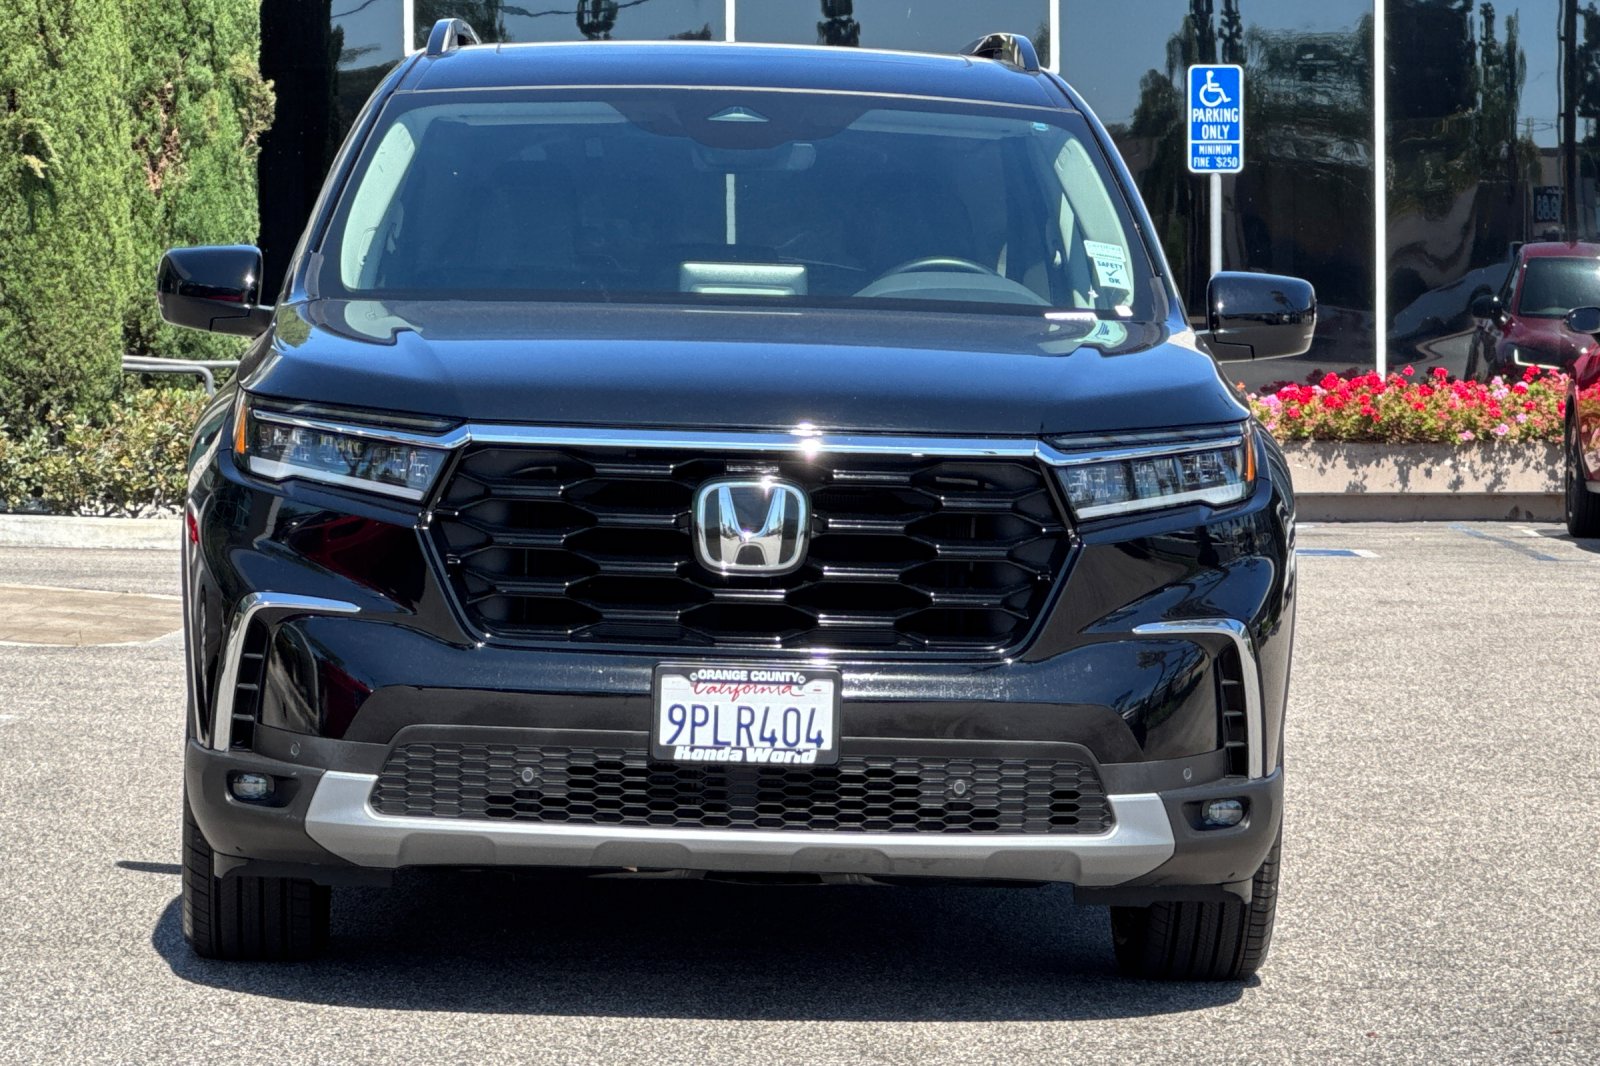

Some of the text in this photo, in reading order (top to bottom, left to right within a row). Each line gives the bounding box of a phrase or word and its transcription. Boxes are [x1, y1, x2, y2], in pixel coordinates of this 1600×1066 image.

[1192, 108, 1239, 123] PARKING
[1201, 124, 1230, 140] ONLY
[1198, 145, 1233, 155] MINIMUM
[1193, 157, 1210, 168] FINE
[1097, 260, 1123, 270] SAFETY
[697, 669, 800, 684] ORANGE COUNTY
[692, 682, 805, 703] California
[666, 703, 825, 749] 9PLR404
[673, 746, 818, 764] Honda World
